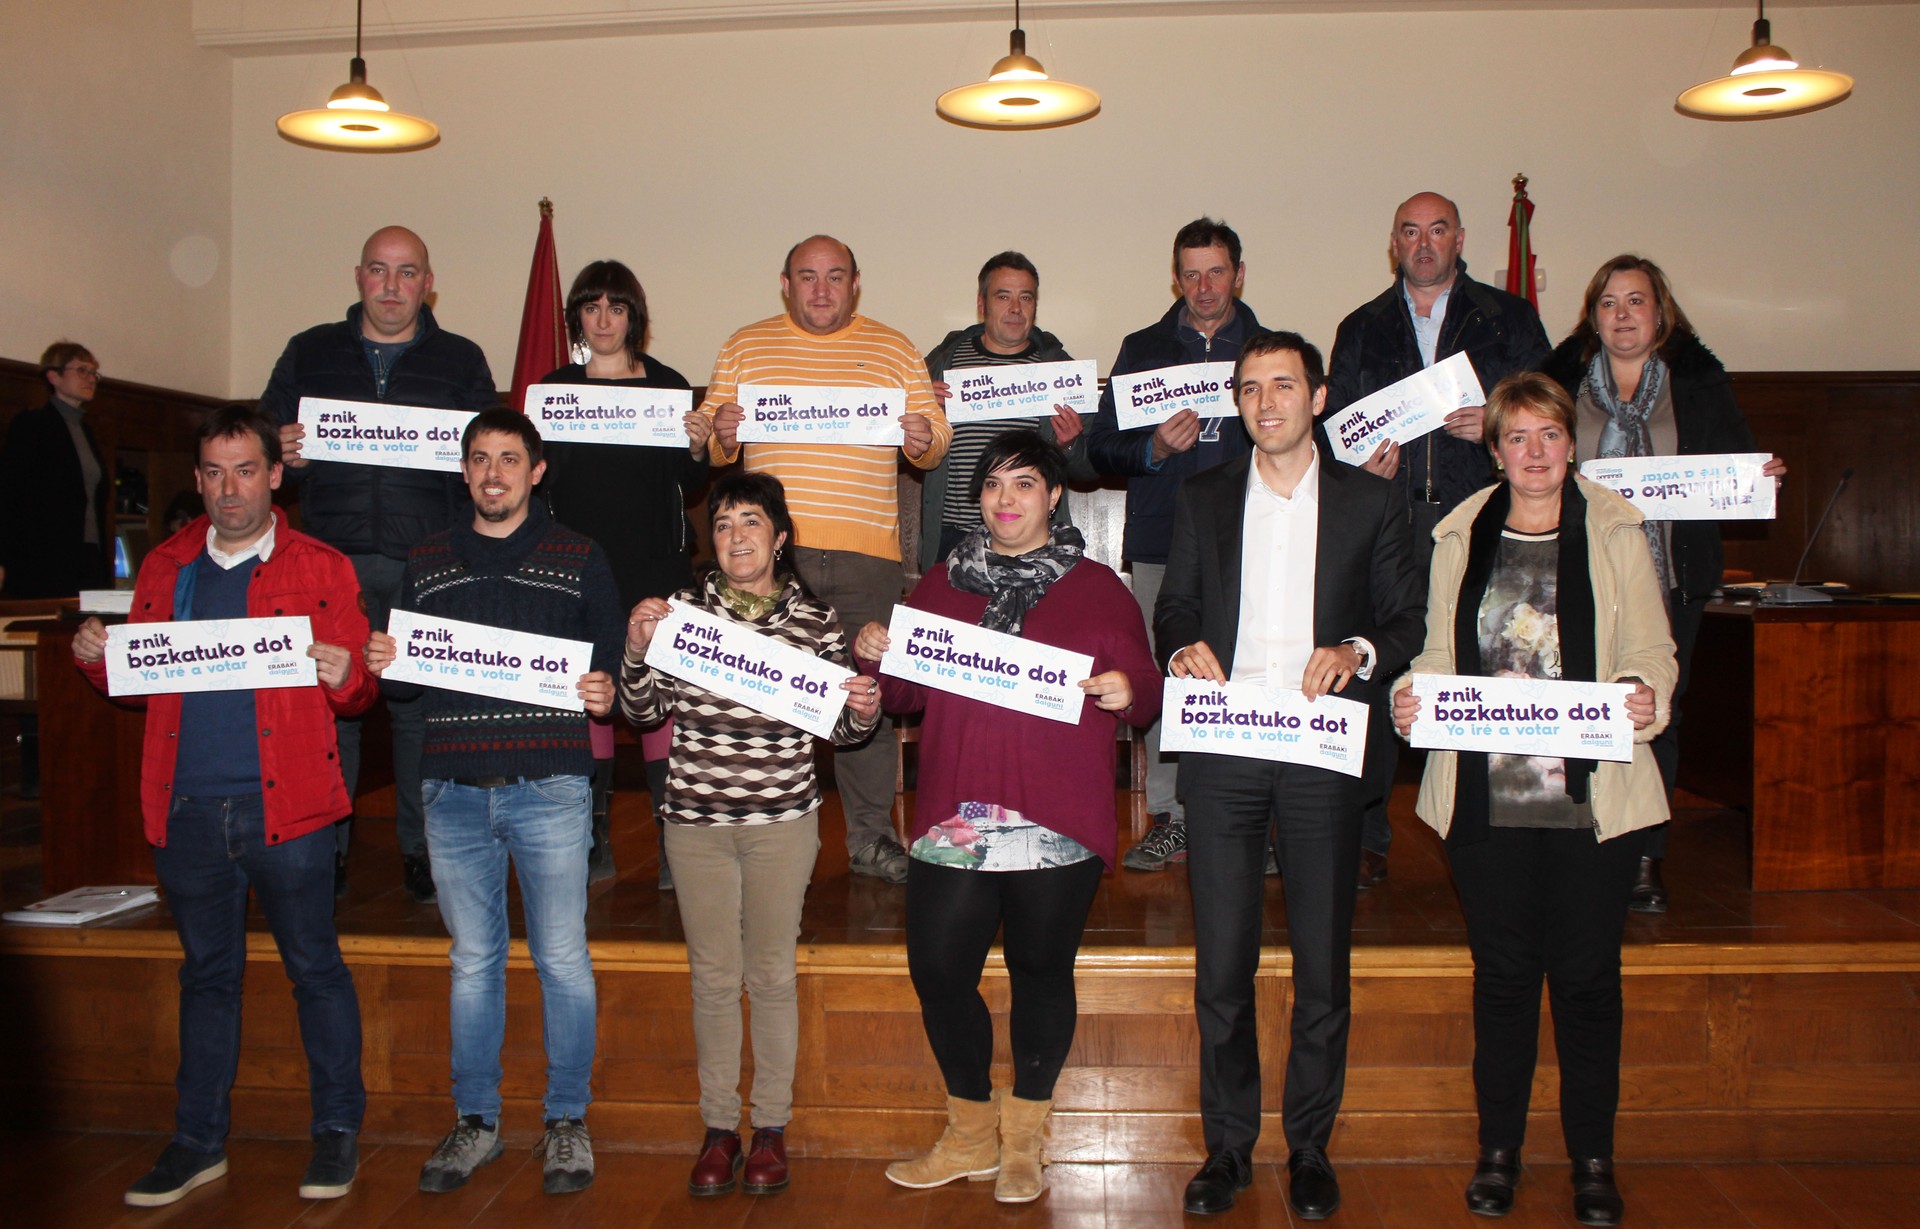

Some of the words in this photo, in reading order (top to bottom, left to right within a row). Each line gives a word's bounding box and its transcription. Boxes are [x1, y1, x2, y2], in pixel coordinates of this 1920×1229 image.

[960, 380, 1048, 403] bozkatuko
[1053, 374, 1083, 389] dot
[961, 375, 995, 389] #nik
[1132, 377, 1166, 393] #nik
[544, 393, 580, 406] #nik
[757, 394, 792, 407] #nik
[1131, 380, 1219, 407] bozkatuko
[969, 402, 984, 411] Yo
[987, 399, 1003, 409] iré
[1006, 398, 1015, 406] a
[1018, 393, 1050, 405] votar
[1141, 405, 1156, 415] Yo
[1160, 400, 1177, 412] iré
[1181, 399, 1189, 407] a
[1192, 393, 1221, 405] votar
[318, 410, 358, 424] #nik
[541, 405, 637, 420] bozkatuko
[643, 404, 675, 419] dot
[755, 405, 850, 421] bozkatuko
[856, 403, 888, 417] dot
[549, 422, 564, 431] Yo
[569, 421, 586, 431] iré
[603, 421, 637, 430] votar
[763, 422, 778, 432] Yo
[783, 421, 799, 431] iré
[804, 423, 813, 431] a
[817, 420, 851, 430] votar
[1338, 410, 1367, 435] #nik
[316, 424, 419, 441] bozkatuko
[426, 427, 460, 441] dot
[324, 440, 341, 451] Yo
[346, 441, 364, 451] iré
[369, 443, 378, 452] a
[383, 443, 419, 452] votar
[1351, 443, 1366, 455] Yo
[1367, 430, 1384, 446] iré
[1641, 472, 1679, 483] votar
[1685, 470, 1695, 479] a
[410, 628, 453, 643] #nik
[681, 622, 724, 645] #nik
[912, 627, 955, 645] #nik
[128, 633, 172, 651] #nik
[126, 642, 245, 669] bozkatuko
[253, 634, 293, 654] dot
[407, 641, 522, 669] bozkatuko
[530, 655, 569, 674] dot
[139, 670, 159, 681] Yo
[164, 664, 185, 678] iré
[191, 666, 202, 676] a
[206, 659, 248, 674] votar
[268, 662, 297, 670] ERABAKI
[672, 633, 783, 682] bozkatuko
[790, 674, 828, 699] dot
[906, 638, 1020, 676] bozkatuko
[1028, 665, 1068, 687] dot
[415, 660, 433, 672] Yo
[440, 662, 459, 675] iré
[465, 668, 475, 677] a
[481, 669, 522, 682] votar
[678, 654, 695, 669] Yo
[700, 661, 720, 677] iré
[724, 672, 734, 682] a
[740, 677, 779, 696] votar
[913, 659, 931, 672] Yo
[937, 663, 957, 678] iré
[962, 672, 972, 681] a
[978, 674, 1018, 690] votar
[539, 682, 568, 690] ERABAKI
[1035, 693, 1065, 704] ERABAKI
[1184, 691, 1228, 706] #nik
[1437, 687, 1483, 703] #nik
[793, 702, 822, 715] ERABAKI
[1434, 704, 1559, 722] bozkatuko
[1568, 703, 1611, 721] dot
[1181, 708, 1301, 729] bozkatuko
[1309, 714, 1348, 735] dot
[1445, 724, 1465, 736] Yo
[1471, 723, 1492, 736] iré
[1498, 725, 1510, 736] a
[1515, 724, 1560, 736] votar
[1189, 727, 1208, 739] Yo
[1214, 727, 1235, 739] iré
[1241, 730, 1252, 740] a
[1258, 730, 1301, 743] votar
[1319, 744, 1347, 753] ERABAKI
